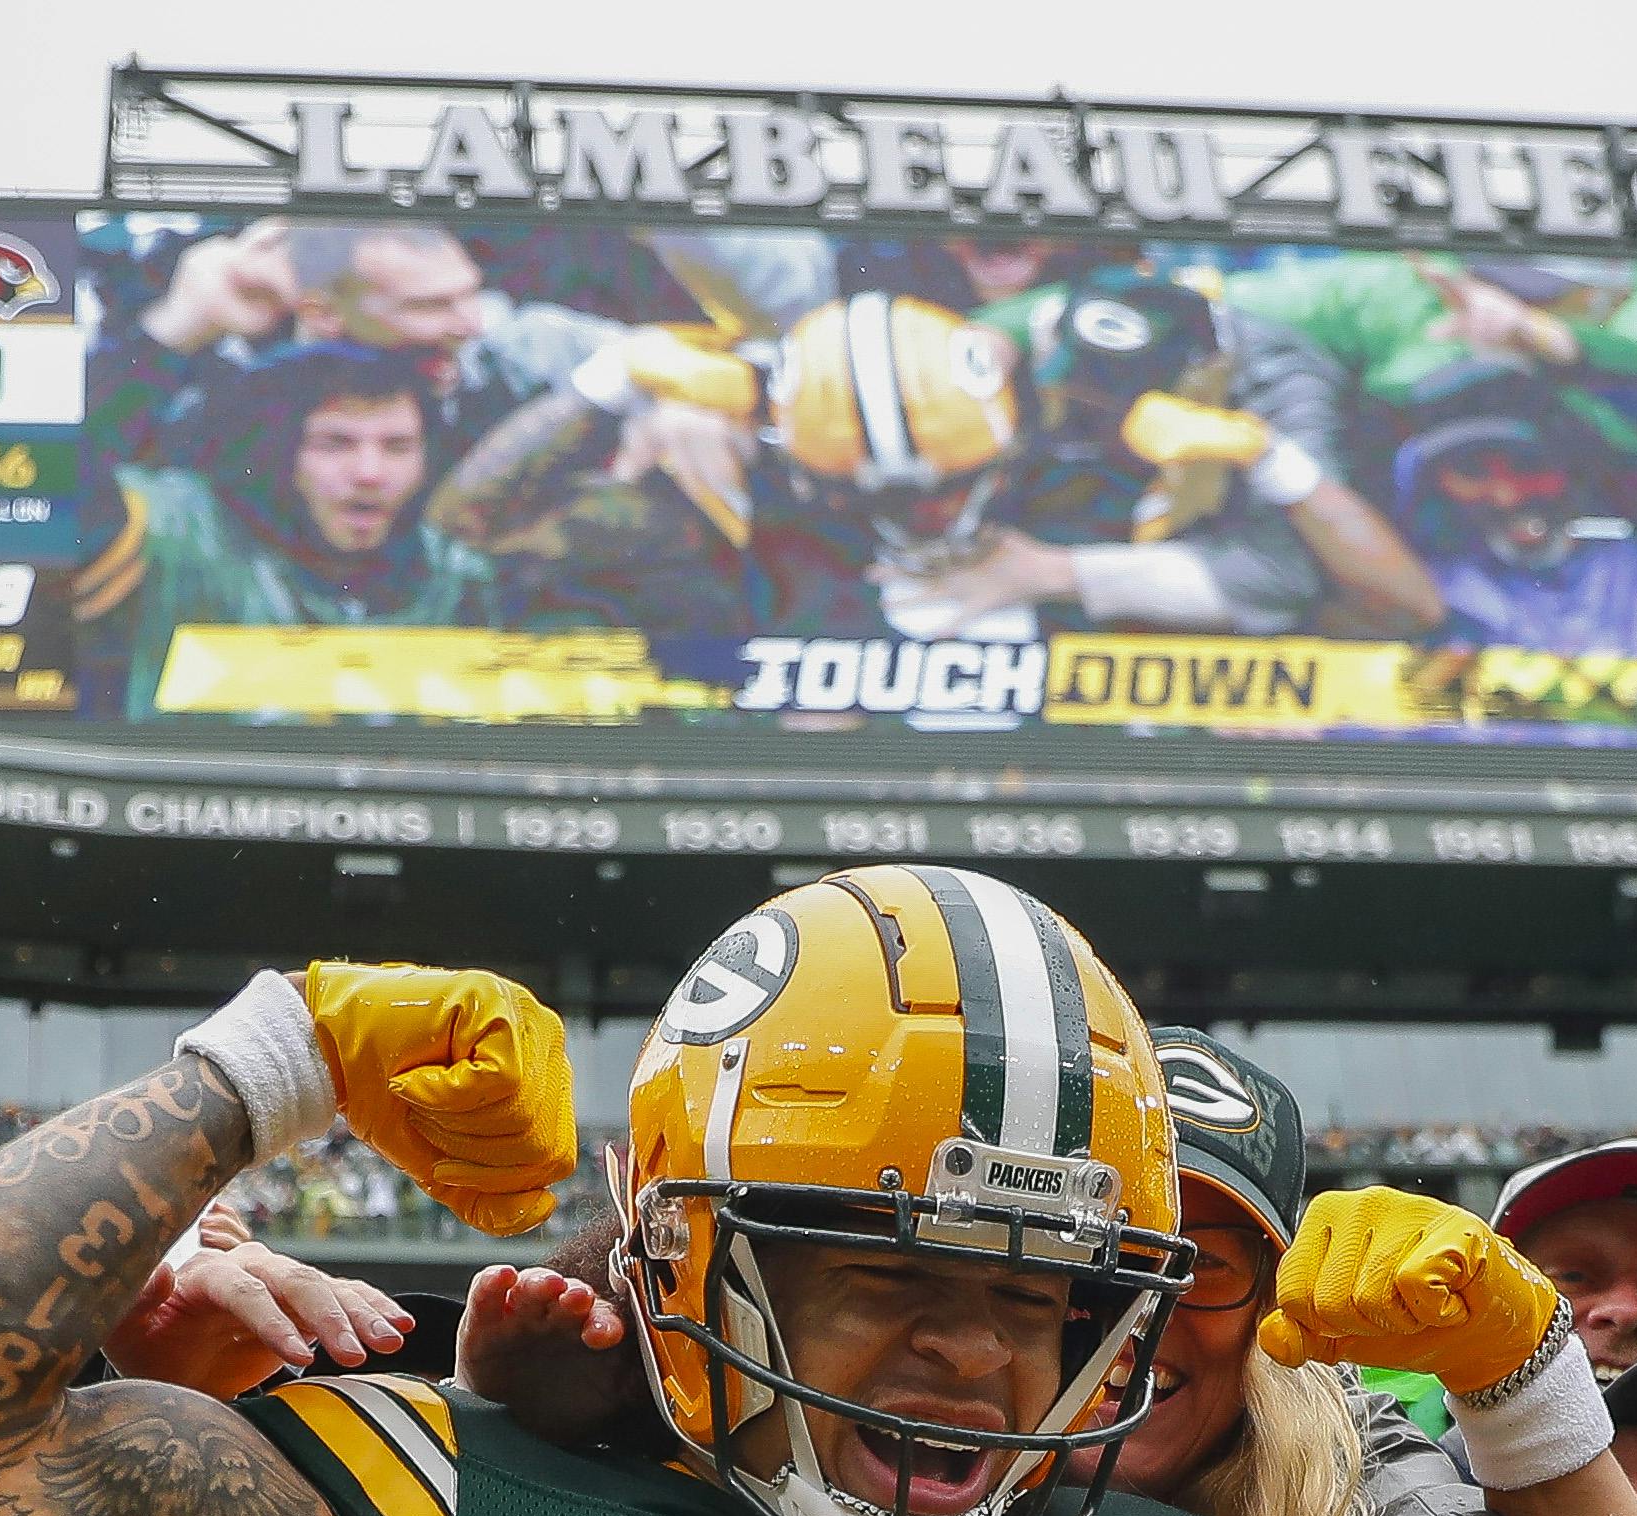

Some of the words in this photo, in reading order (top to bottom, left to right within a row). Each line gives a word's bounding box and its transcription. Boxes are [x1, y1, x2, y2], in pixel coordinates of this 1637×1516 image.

[290, 100, 1231, 223] LAMBEAU
[732, 635, 1047, 714] TOUCH
[1068, 651, 1320, 711] DOWN
[125, 790, 434, 846] CHAMPIONS
[503, 805, 622, 852] 1929
[662, 808, 784, 855] 1930
[821, 808, 928, 855] 1931
[1428, 818, 1536, 863] 1961
[986, 1160, 1064, 1196] PACKERS
